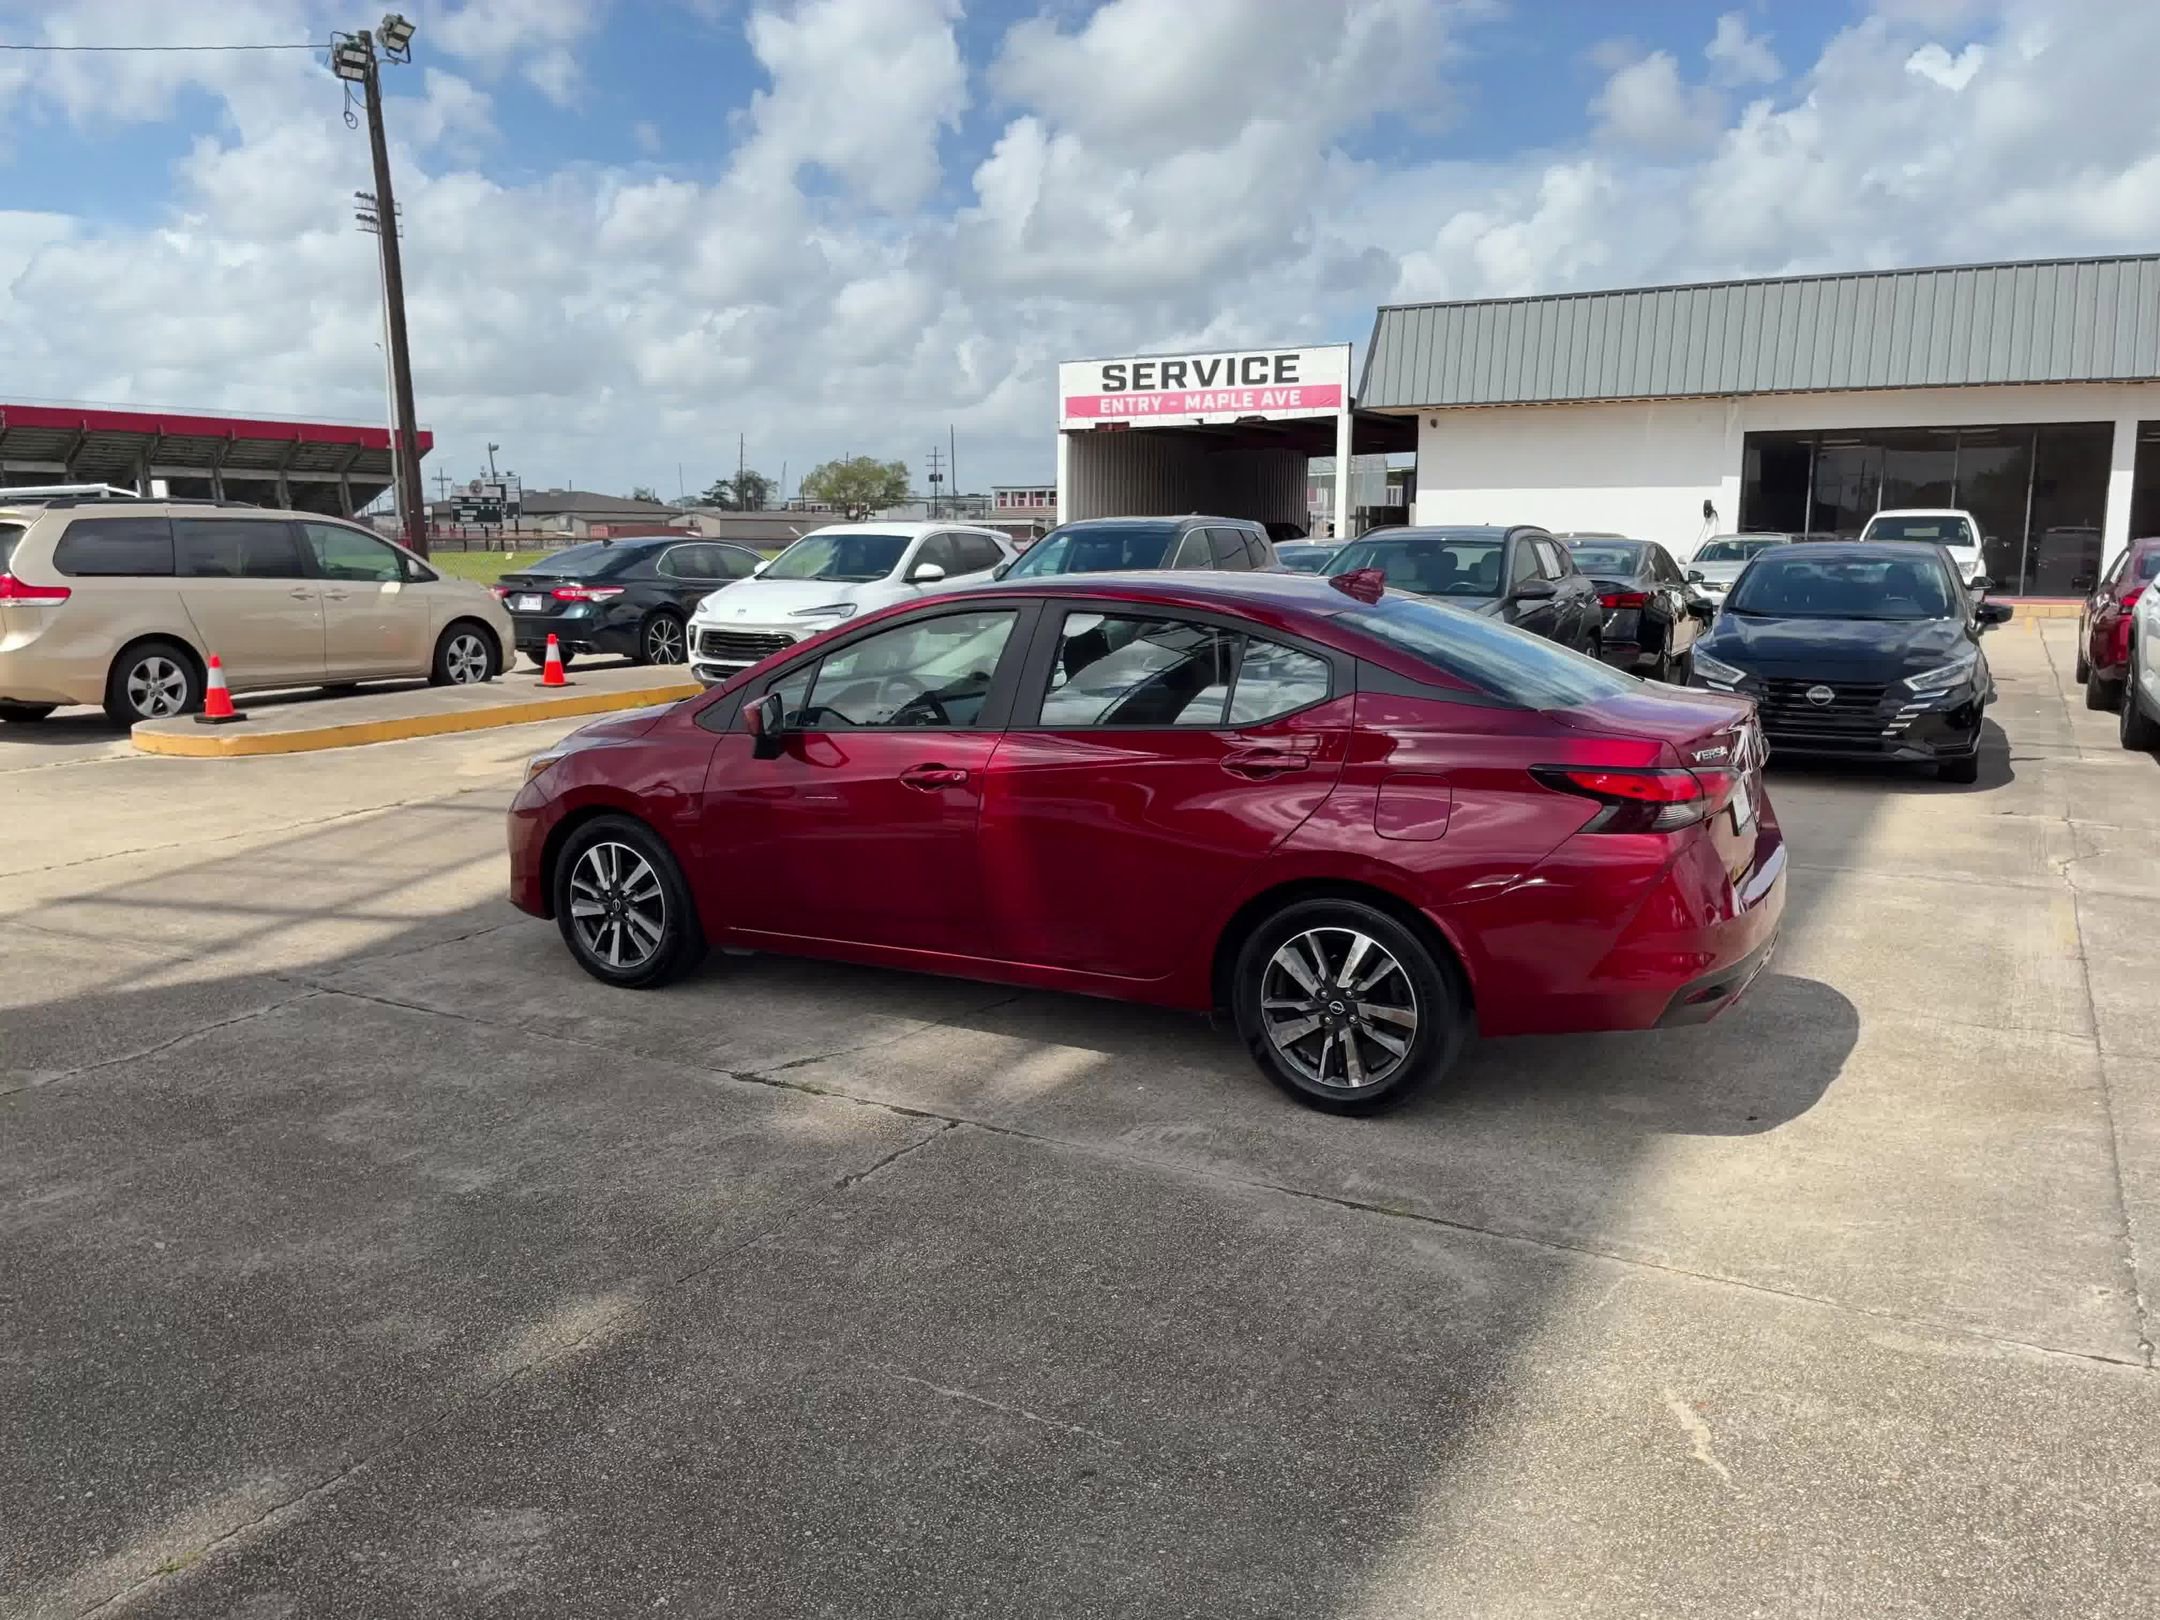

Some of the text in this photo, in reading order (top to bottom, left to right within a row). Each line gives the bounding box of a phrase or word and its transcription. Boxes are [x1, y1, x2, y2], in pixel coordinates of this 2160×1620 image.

[1102, 354, 1300, 392] SERVICE
[1100, 396, 1162, 414] ENTRY
[1185, 391, 1254, 411] MAPLE
[1260, 389, 1302, 406] AVE
